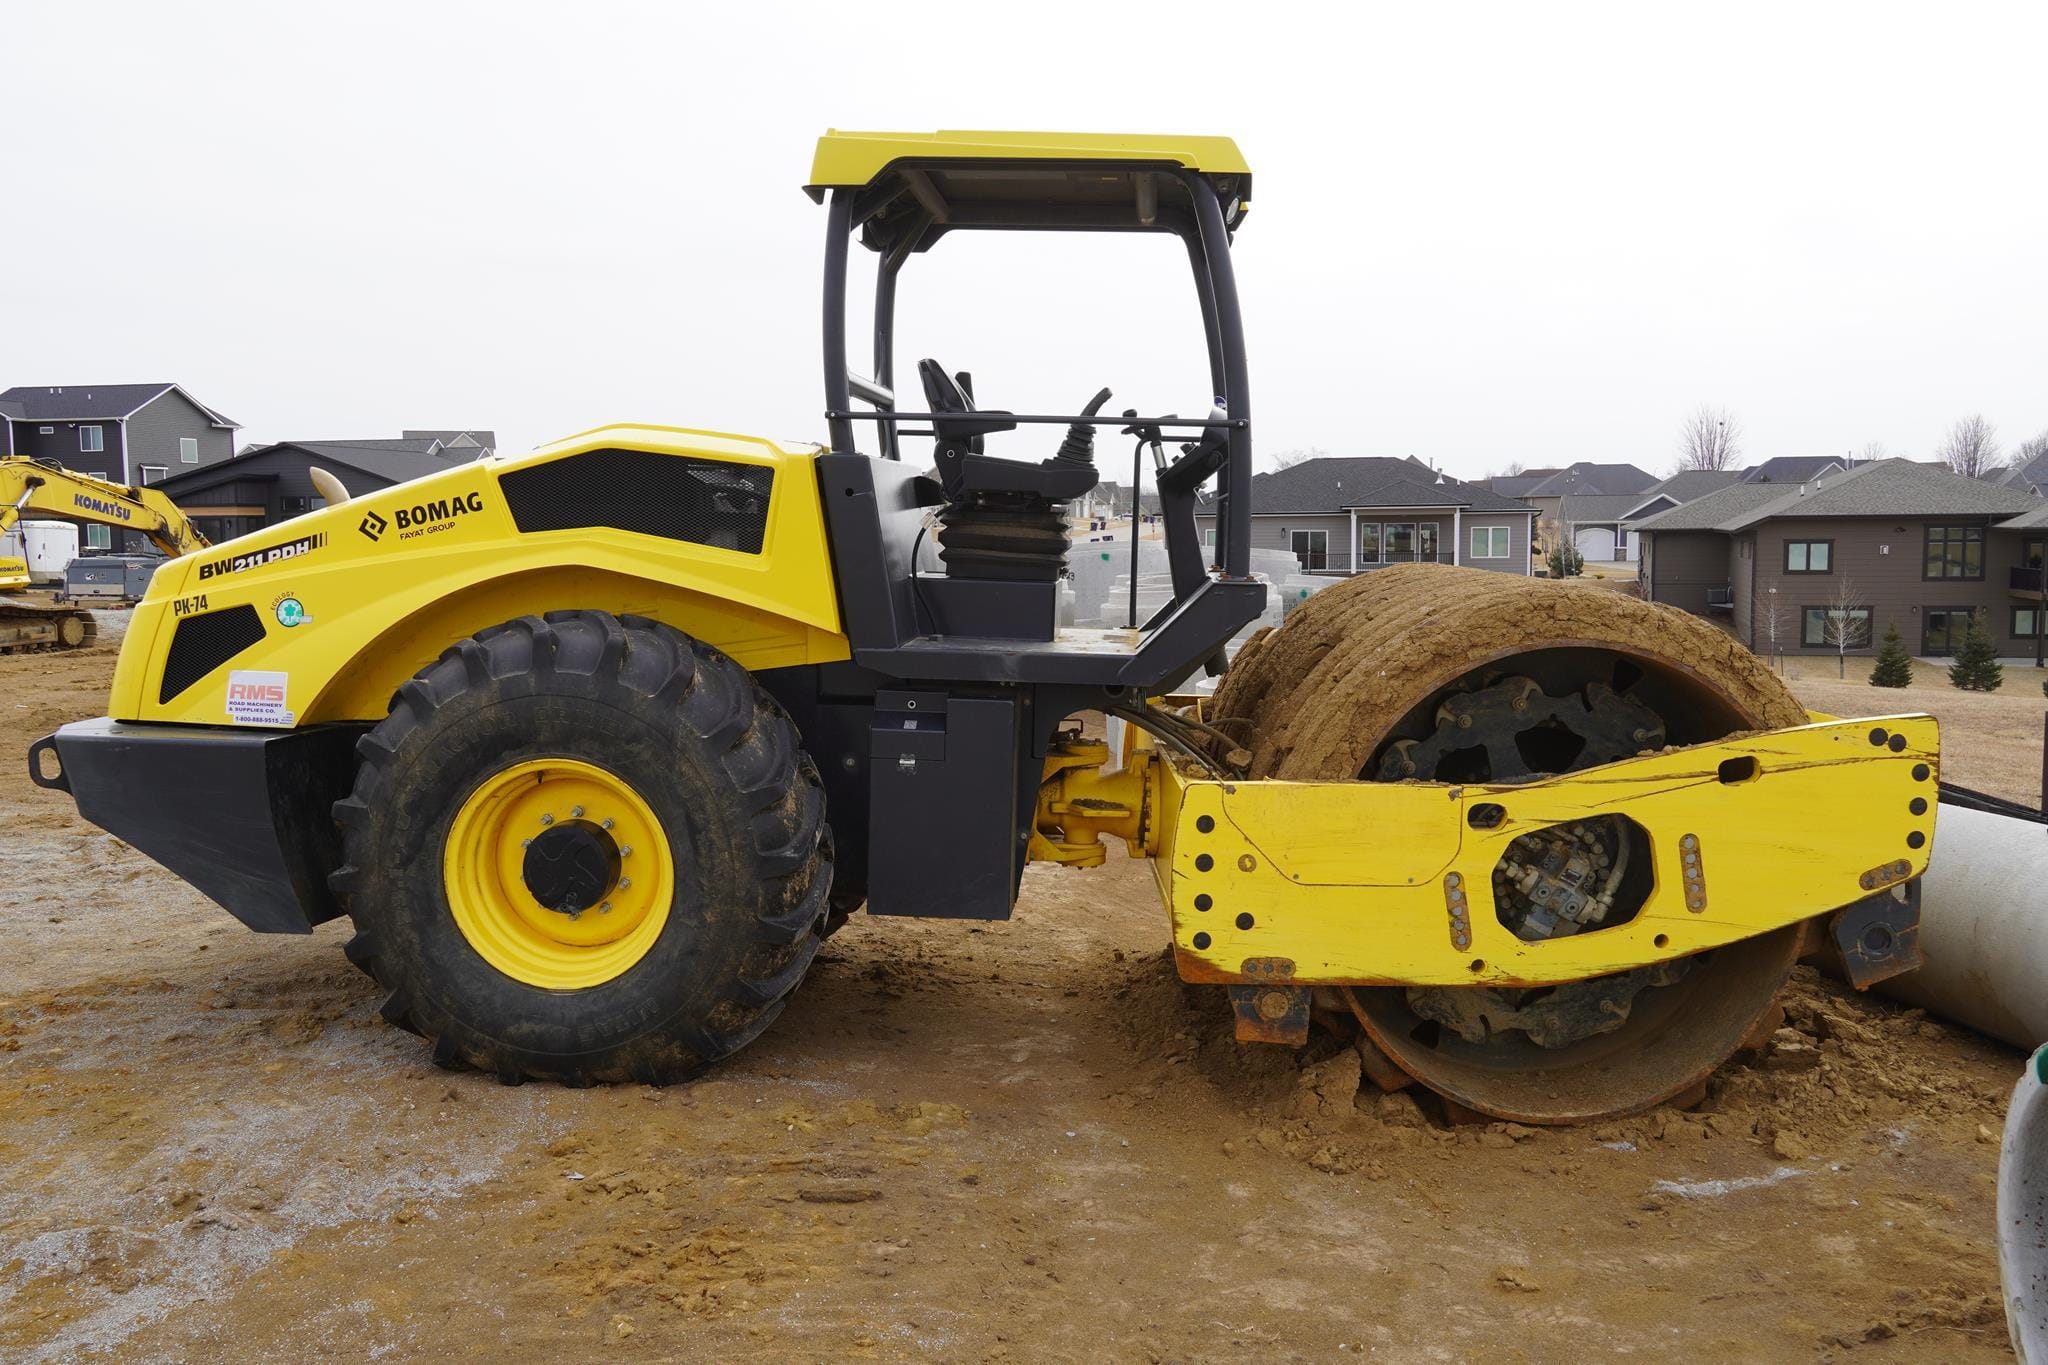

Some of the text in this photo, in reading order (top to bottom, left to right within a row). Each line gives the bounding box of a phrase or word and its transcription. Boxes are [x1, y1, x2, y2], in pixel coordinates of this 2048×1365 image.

[74, 494, 130, 520] KOMATSU
[395, 491, 483, 529] BOMAG
[400, 521, 456, 540] FAYAT GROUP
[173, 594, 208, 616] PK-74
[270, 591, 294, 610] ECOLOGY
[230, 683, 283, 702] RMS
